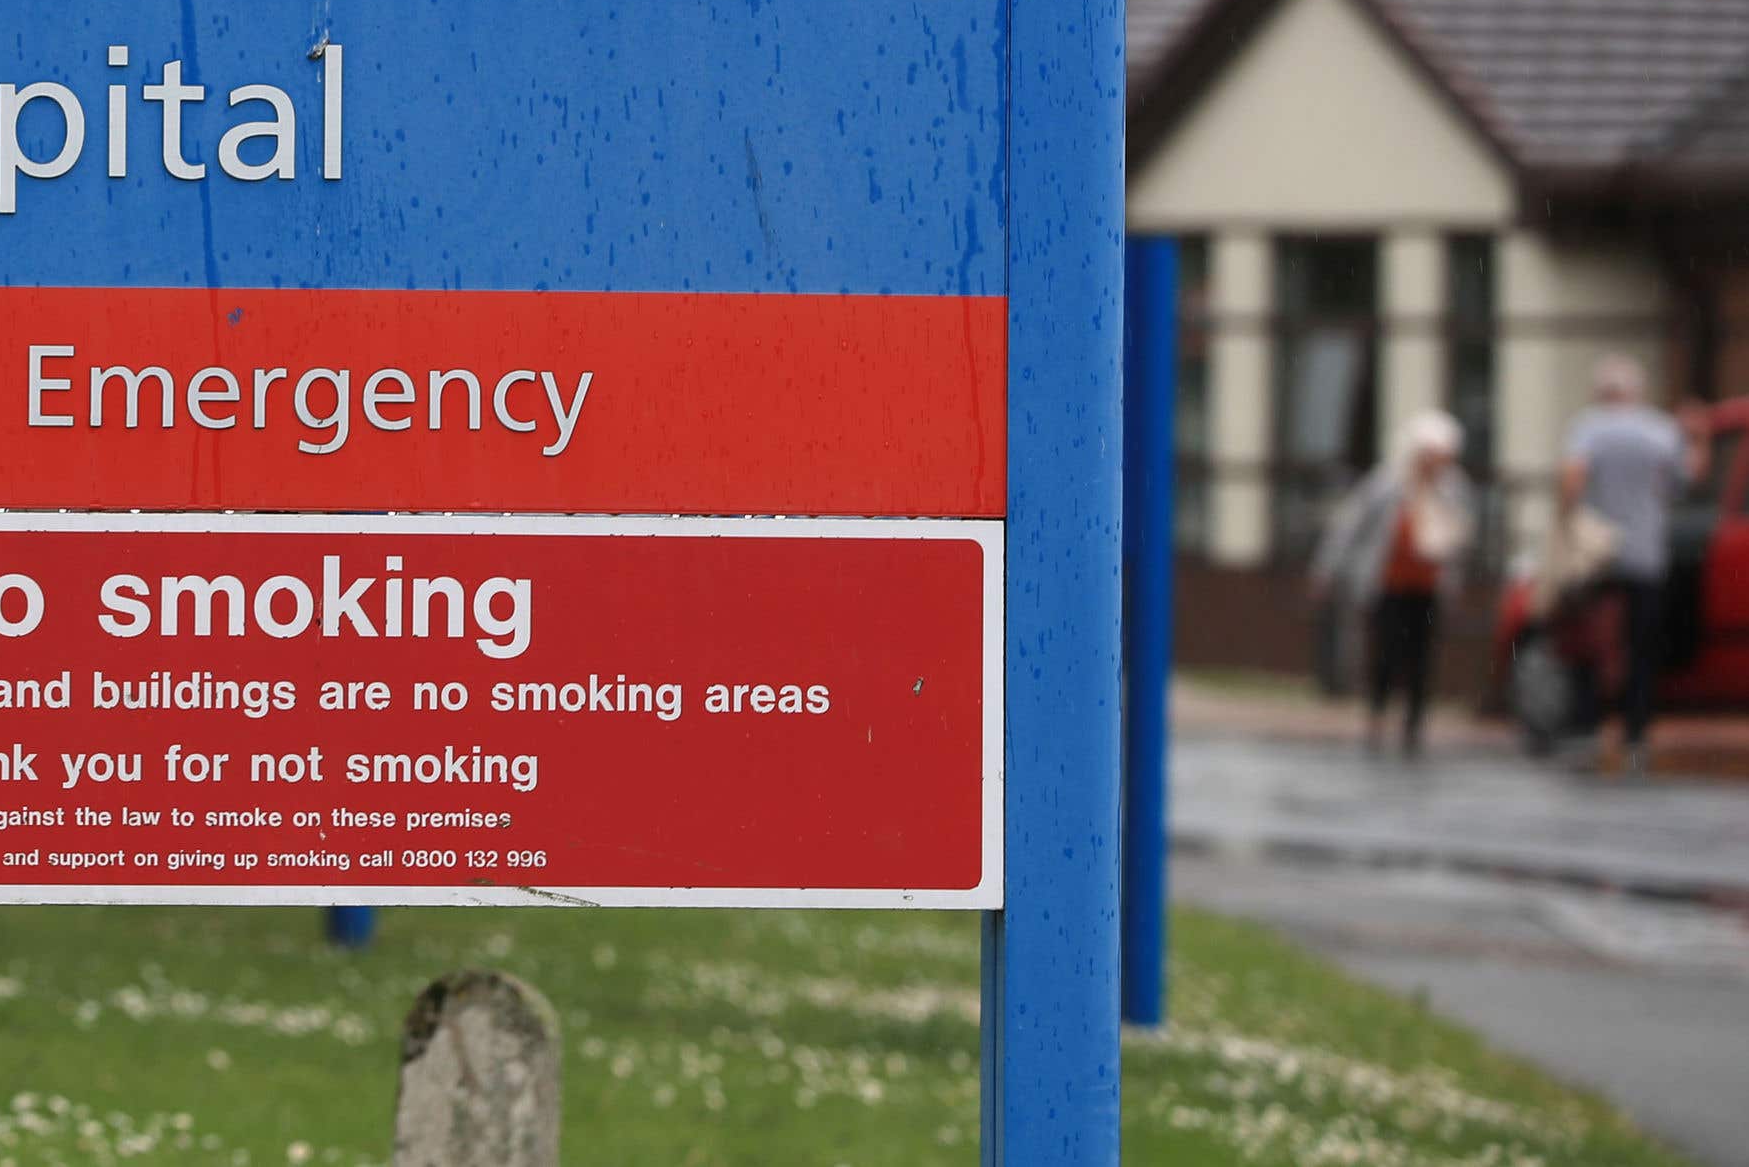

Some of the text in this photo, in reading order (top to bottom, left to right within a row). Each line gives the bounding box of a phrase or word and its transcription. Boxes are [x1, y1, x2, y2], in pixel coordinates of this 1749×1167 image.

[28, 345, 594, 456] Emergency
[97, 555, 532, 659] smoking
[93, 671, 296, 719] buildings
[319, 681, 391, 711] are
[413, 681, 469, 711] no
[490, 673, 682, 721] smoking
[704, 684, 830, 714] areas
[60, 752, 142, 789] you
[164, 744, 230, 783] for
[250, 746, 324, 783] not
[345, 745, 538, 793] smoking
[74, 806, 112, 827] the
[122, 806, 161, 827] law
[170, 807, 195, 827] to
[204, 806, 283, 827] smoke
[292, 811, 321, 828] on
[330, 807, 397, 828] these
[406, 808, 512, 832] premises
[2, 848, 39, 866] and
[47, 849, 126, 870] support
[133, 853, 159, 867] on
[167, 848, 226, 871] giving
[233, 853, 259, 870] up
[266, 849, 351, 871] smoking
[359, 849, 393, 868] call
[401, 849, 457, 868] 0800
[464, 850, 499, 868] 132
[506, 850, 547, 868] 996
